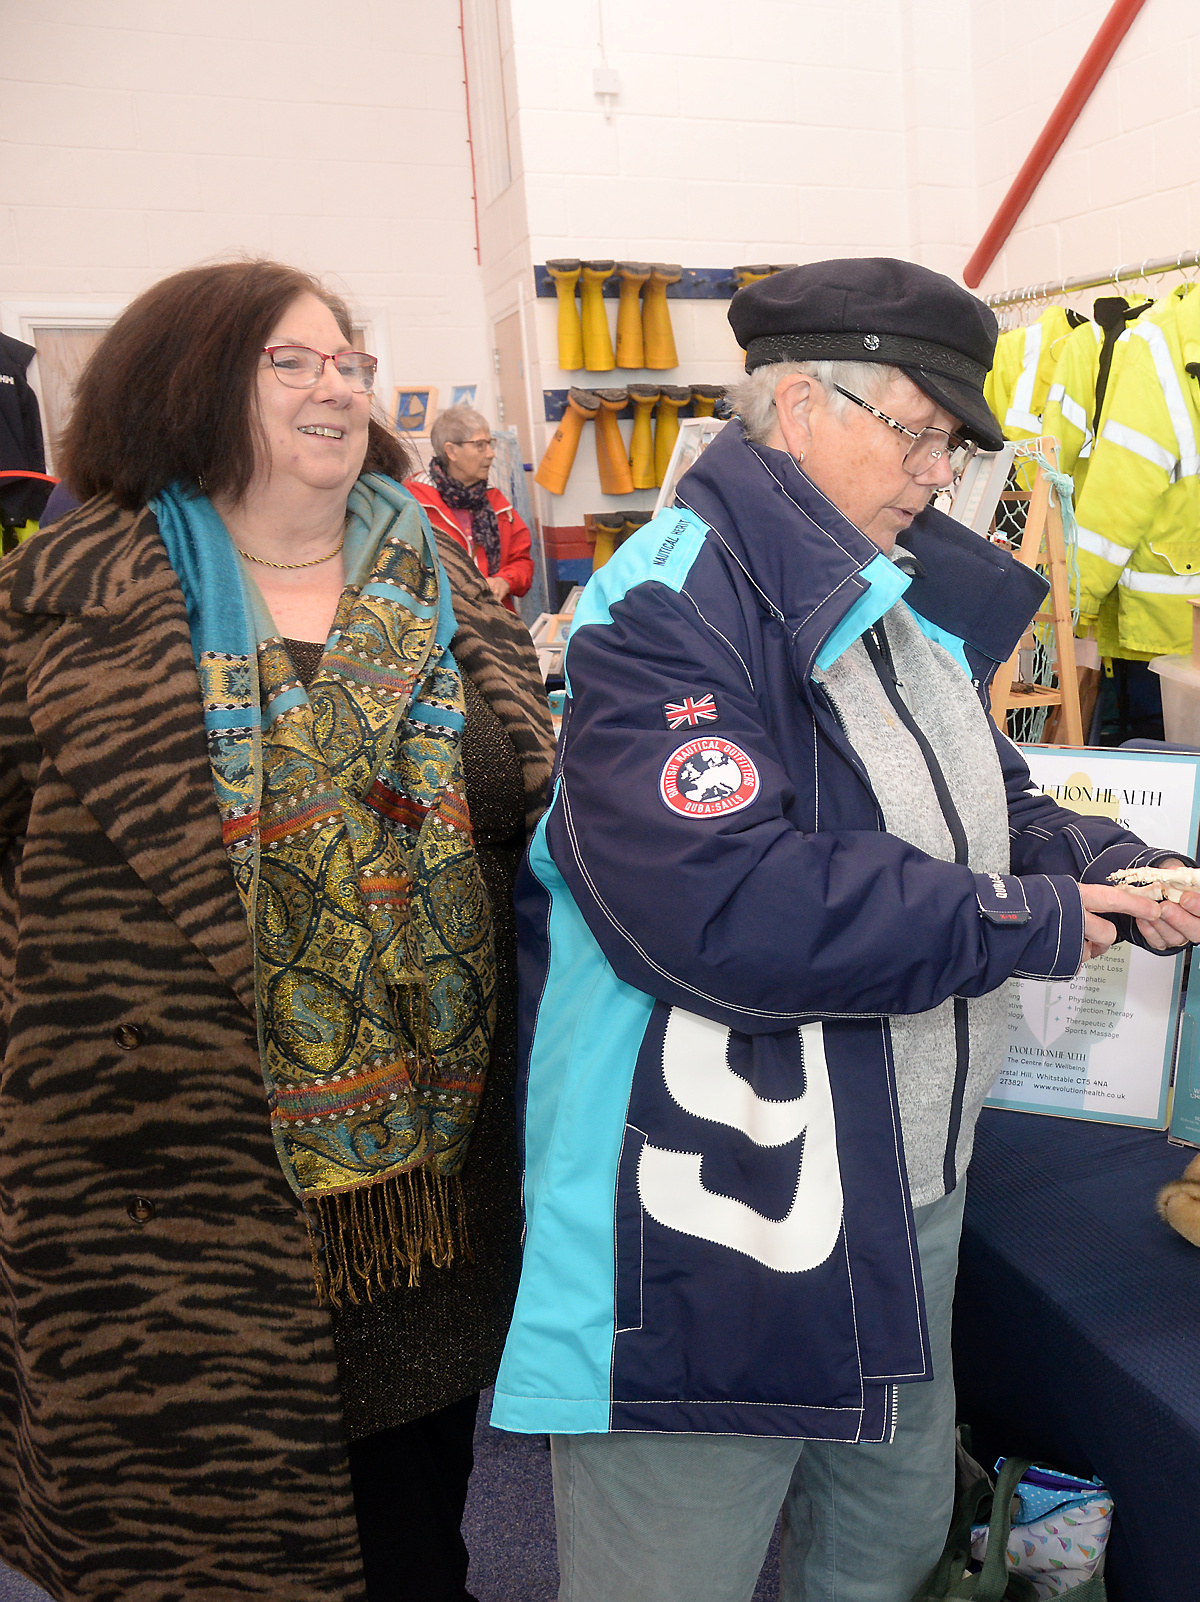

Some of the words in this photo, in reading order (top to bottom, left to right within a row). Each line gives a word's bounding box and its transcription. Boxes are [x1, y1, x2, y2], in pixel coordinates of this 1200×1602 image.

[653, 536, 680, 567] NAUTICAL
[665, 764, 680, 799] BRITISH
[675, 740, 720, 763] NAUTICAL
[723, 744, 754, 787] OUTFITTERS
[684, 794, 744, 814] QUBA:SAILS
[1100, 955, 1125, 963] Fitness
[1081, 962, 1105, 971] Weight
[1072, 975, 1107, 984] ymphatic
[1069, 983, 1100, 993] Drainage
[1068, 995, 1117, 1008] Physiotherapy
[1074, 1005, 1104, 1016] Injection
[1106, 1008, 1134, 1019] Therapy
[1066, 1016, 1106, 1029] Therapeutic
[1064, 1026, 1088, 1036] Sports
[1089, 1029, 1120, 1040] Massage
[1007, 1056, 1019, 1064] The
[1020, 1058, 1042, 1067] Centre
[1043, 1060, 1053, 1068] for
[1055, 1062, 1086, 1073] Wellbeing
[1036, 1073, 1074, 1084] Whitstable
[1076, 1077, 1091, 1086] CT5
[1093, 1080, 1108, 1088] 4NA
[999, 1079, 1023, 1087] 273821
[1033, 1083, 1126, 1100] www.evolutionhealth.co.uk
